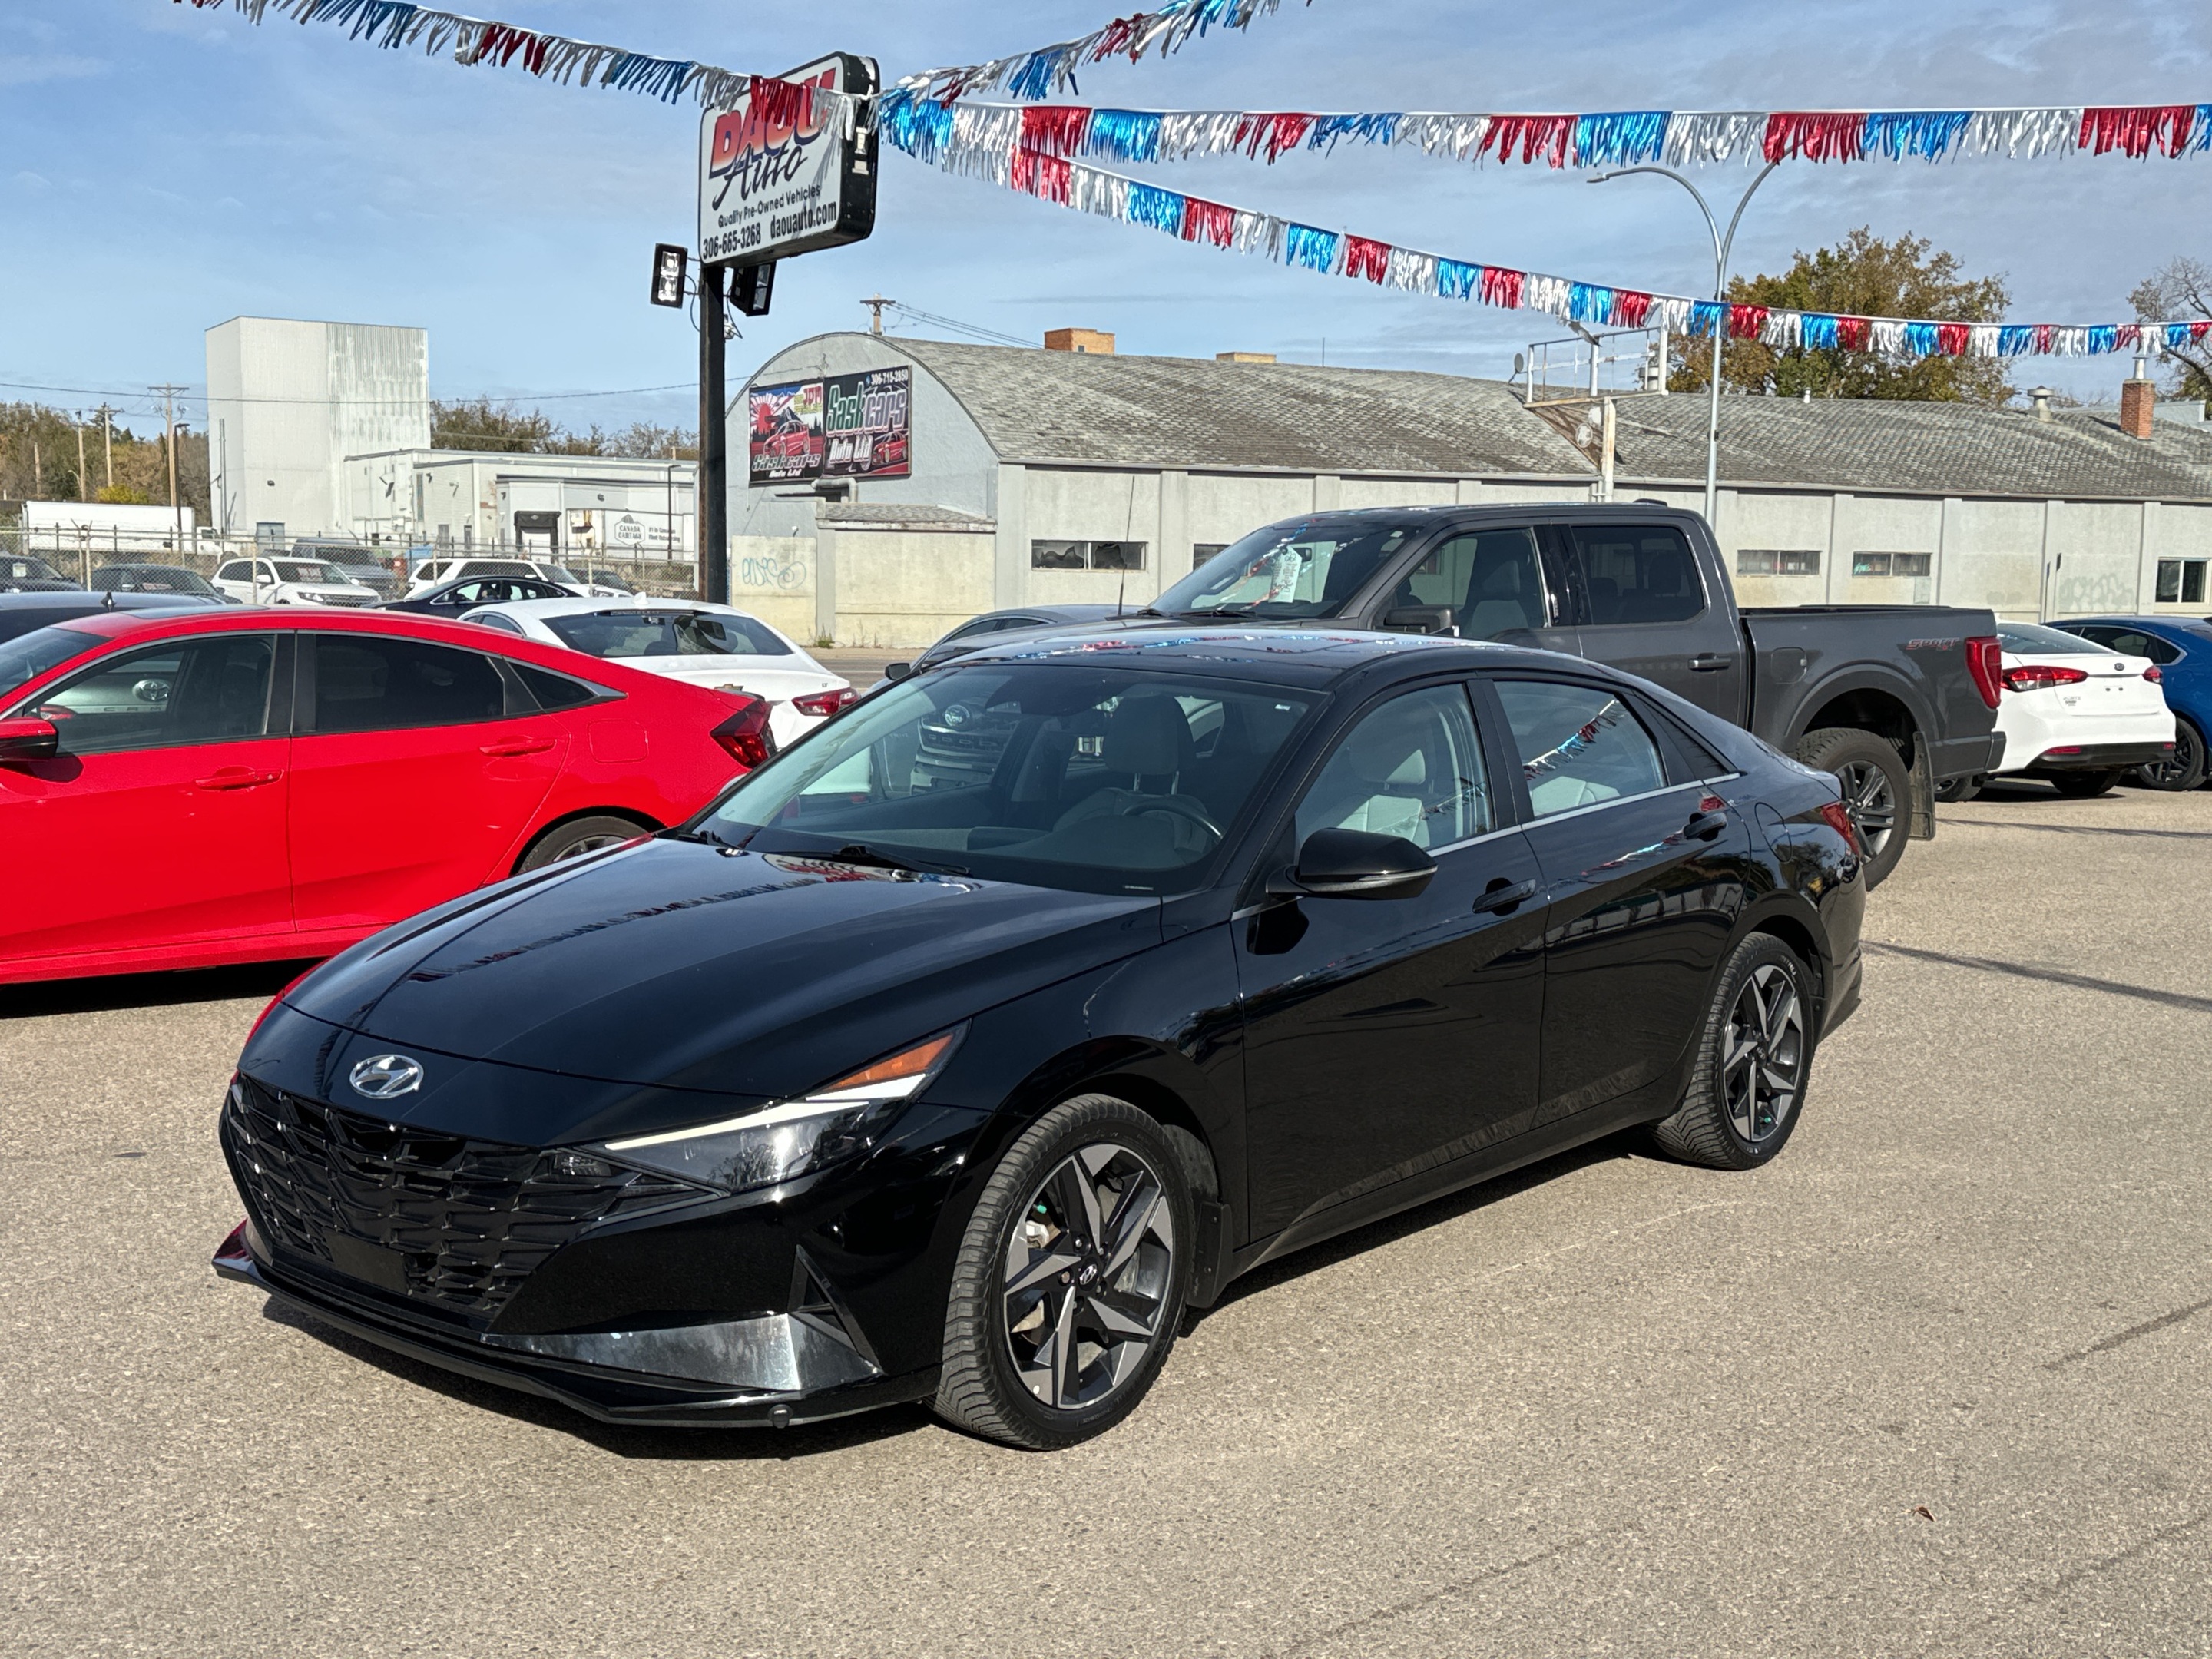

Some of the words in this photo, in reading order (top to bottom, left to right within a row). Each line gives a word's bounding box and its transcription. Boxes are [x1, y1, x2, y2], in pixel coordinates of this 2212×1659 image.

[712, 141, 808, 211] Auto
[703, 222, 761, 260] 306-665-3268
[770, 201, 836, 240] daouauto.com
[718, 209, 743, 229] Quality
[743, 194, 784, 220] Pre-Owned
[785, 184, 821, 205] Vehicles
[826, 381, 907, 438] Saskcars
[1906, 637, 1960, 651] SPORT
